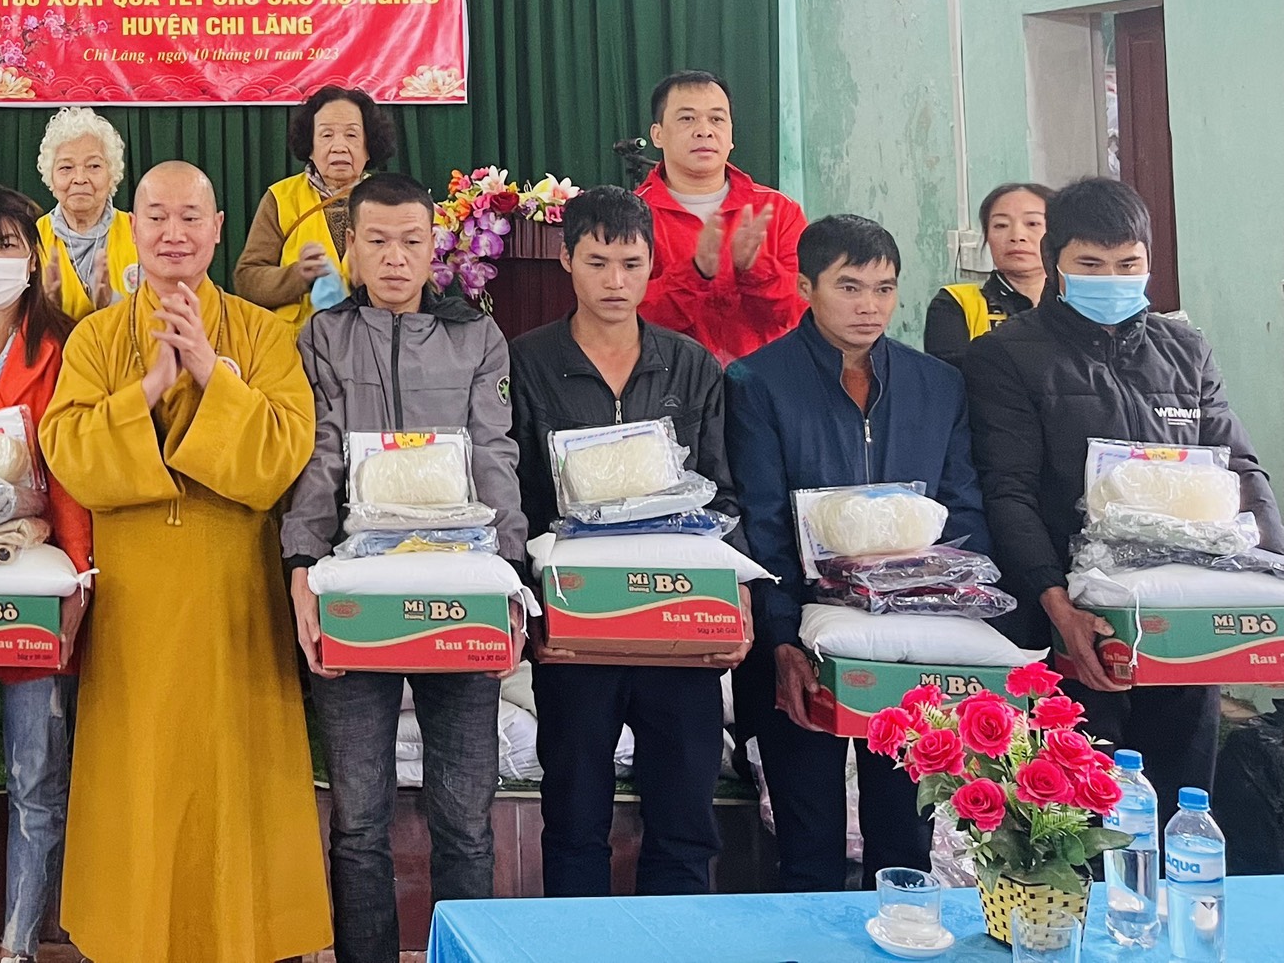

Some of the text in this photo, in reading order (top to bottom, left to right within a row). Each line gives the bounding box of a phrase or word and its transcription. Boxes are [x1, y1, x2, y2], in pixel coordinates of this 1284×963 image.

[122, 13, 313, 39] HUYỆN CHI LĂNG
[111, 48, 145, 64] Lăng
[157, 49, 189, 64] ngày
[193, 48, 209, 61] 10
[213, 47, 250, 64] tháng
[254, 48, 269, 61] 01
[274, 48, 303, 61] năm
[307, 48, 339, 61] 2023
[628, 573, 692, 593] Mì Bò
[404, 600, 466, 620] Mì Bò
[662, 611, 736, 624] Rau Thơm
[1214, 614, 1277, 634] Mì Bò
[17, 639, 53, 651] Thơm
[435, 639, 507, 651] Rau Thơm
[1249, 653, 1277, 665] Rau
[920, 673, 984, 695] Mì Bò
